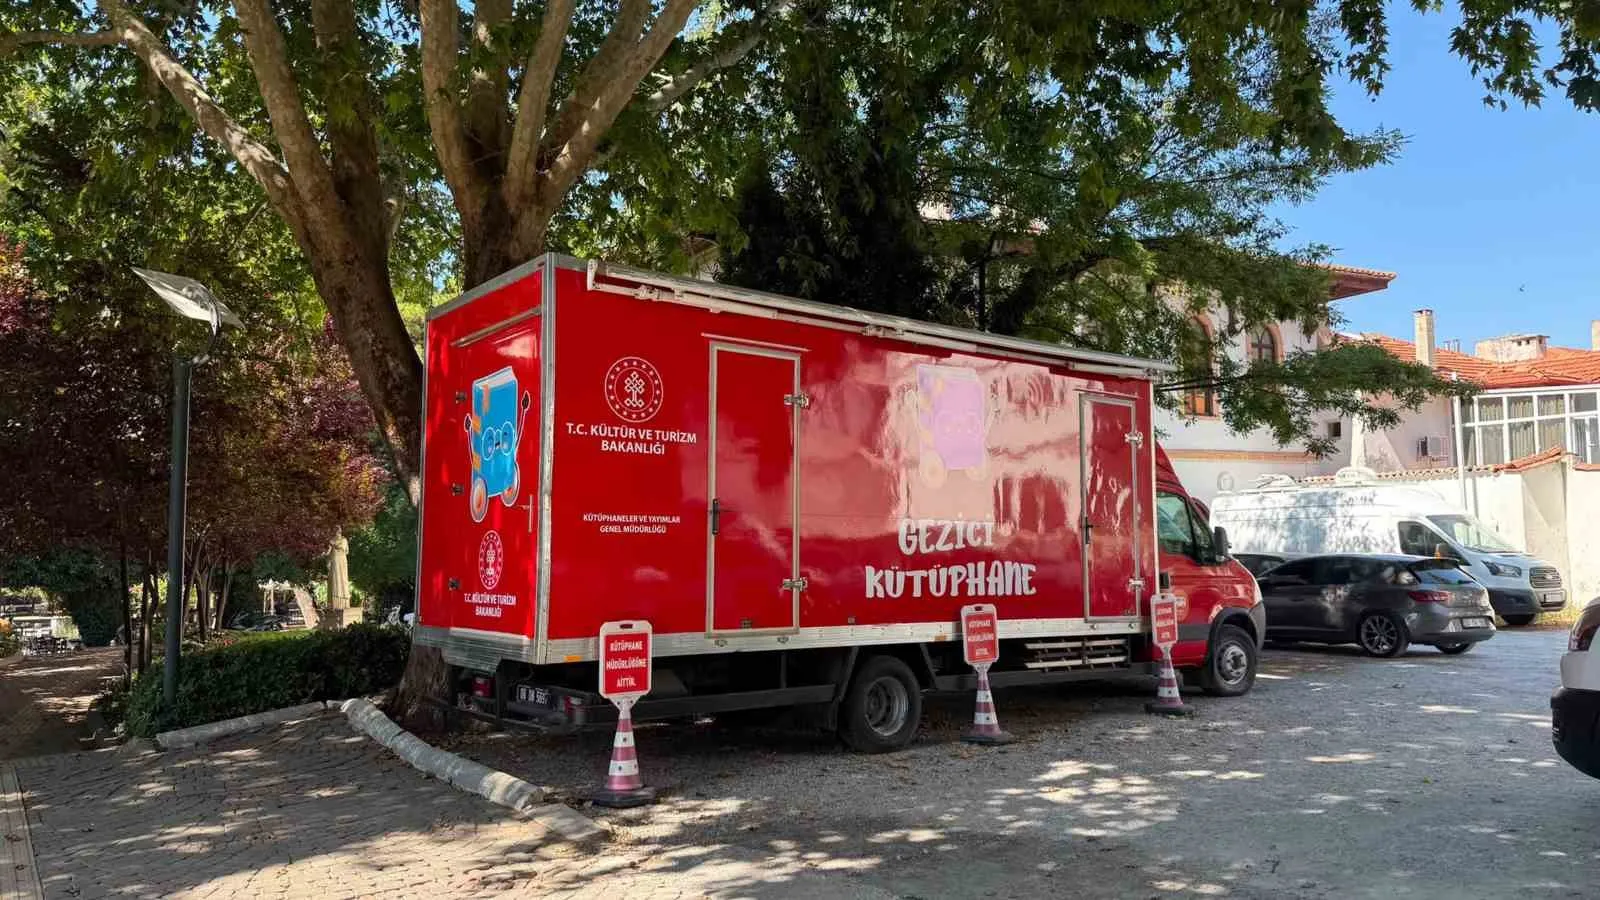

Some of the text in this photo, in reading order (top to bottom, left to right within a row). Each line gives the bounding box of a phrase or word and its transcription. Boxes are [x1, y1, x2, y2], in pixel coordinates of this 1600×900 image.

[566, 422, 697, 444] T.C. KÜLTÜR VE TURİZM
[601, 440, 665, 455] BAKANLIĞI
[583, 512, 638, 523] KÜTÜPHANELER
[639, 514, 648, 523] VE
[599, 523, 667, 534] GENEL MÜDÜRLÜĞÜ
[898, 514, 994, 555] GEZİCİ
[865, 560, 1037, 599] KÜTÜPHANE
[609, 640, 643, 652] KÜTÜPHANE
